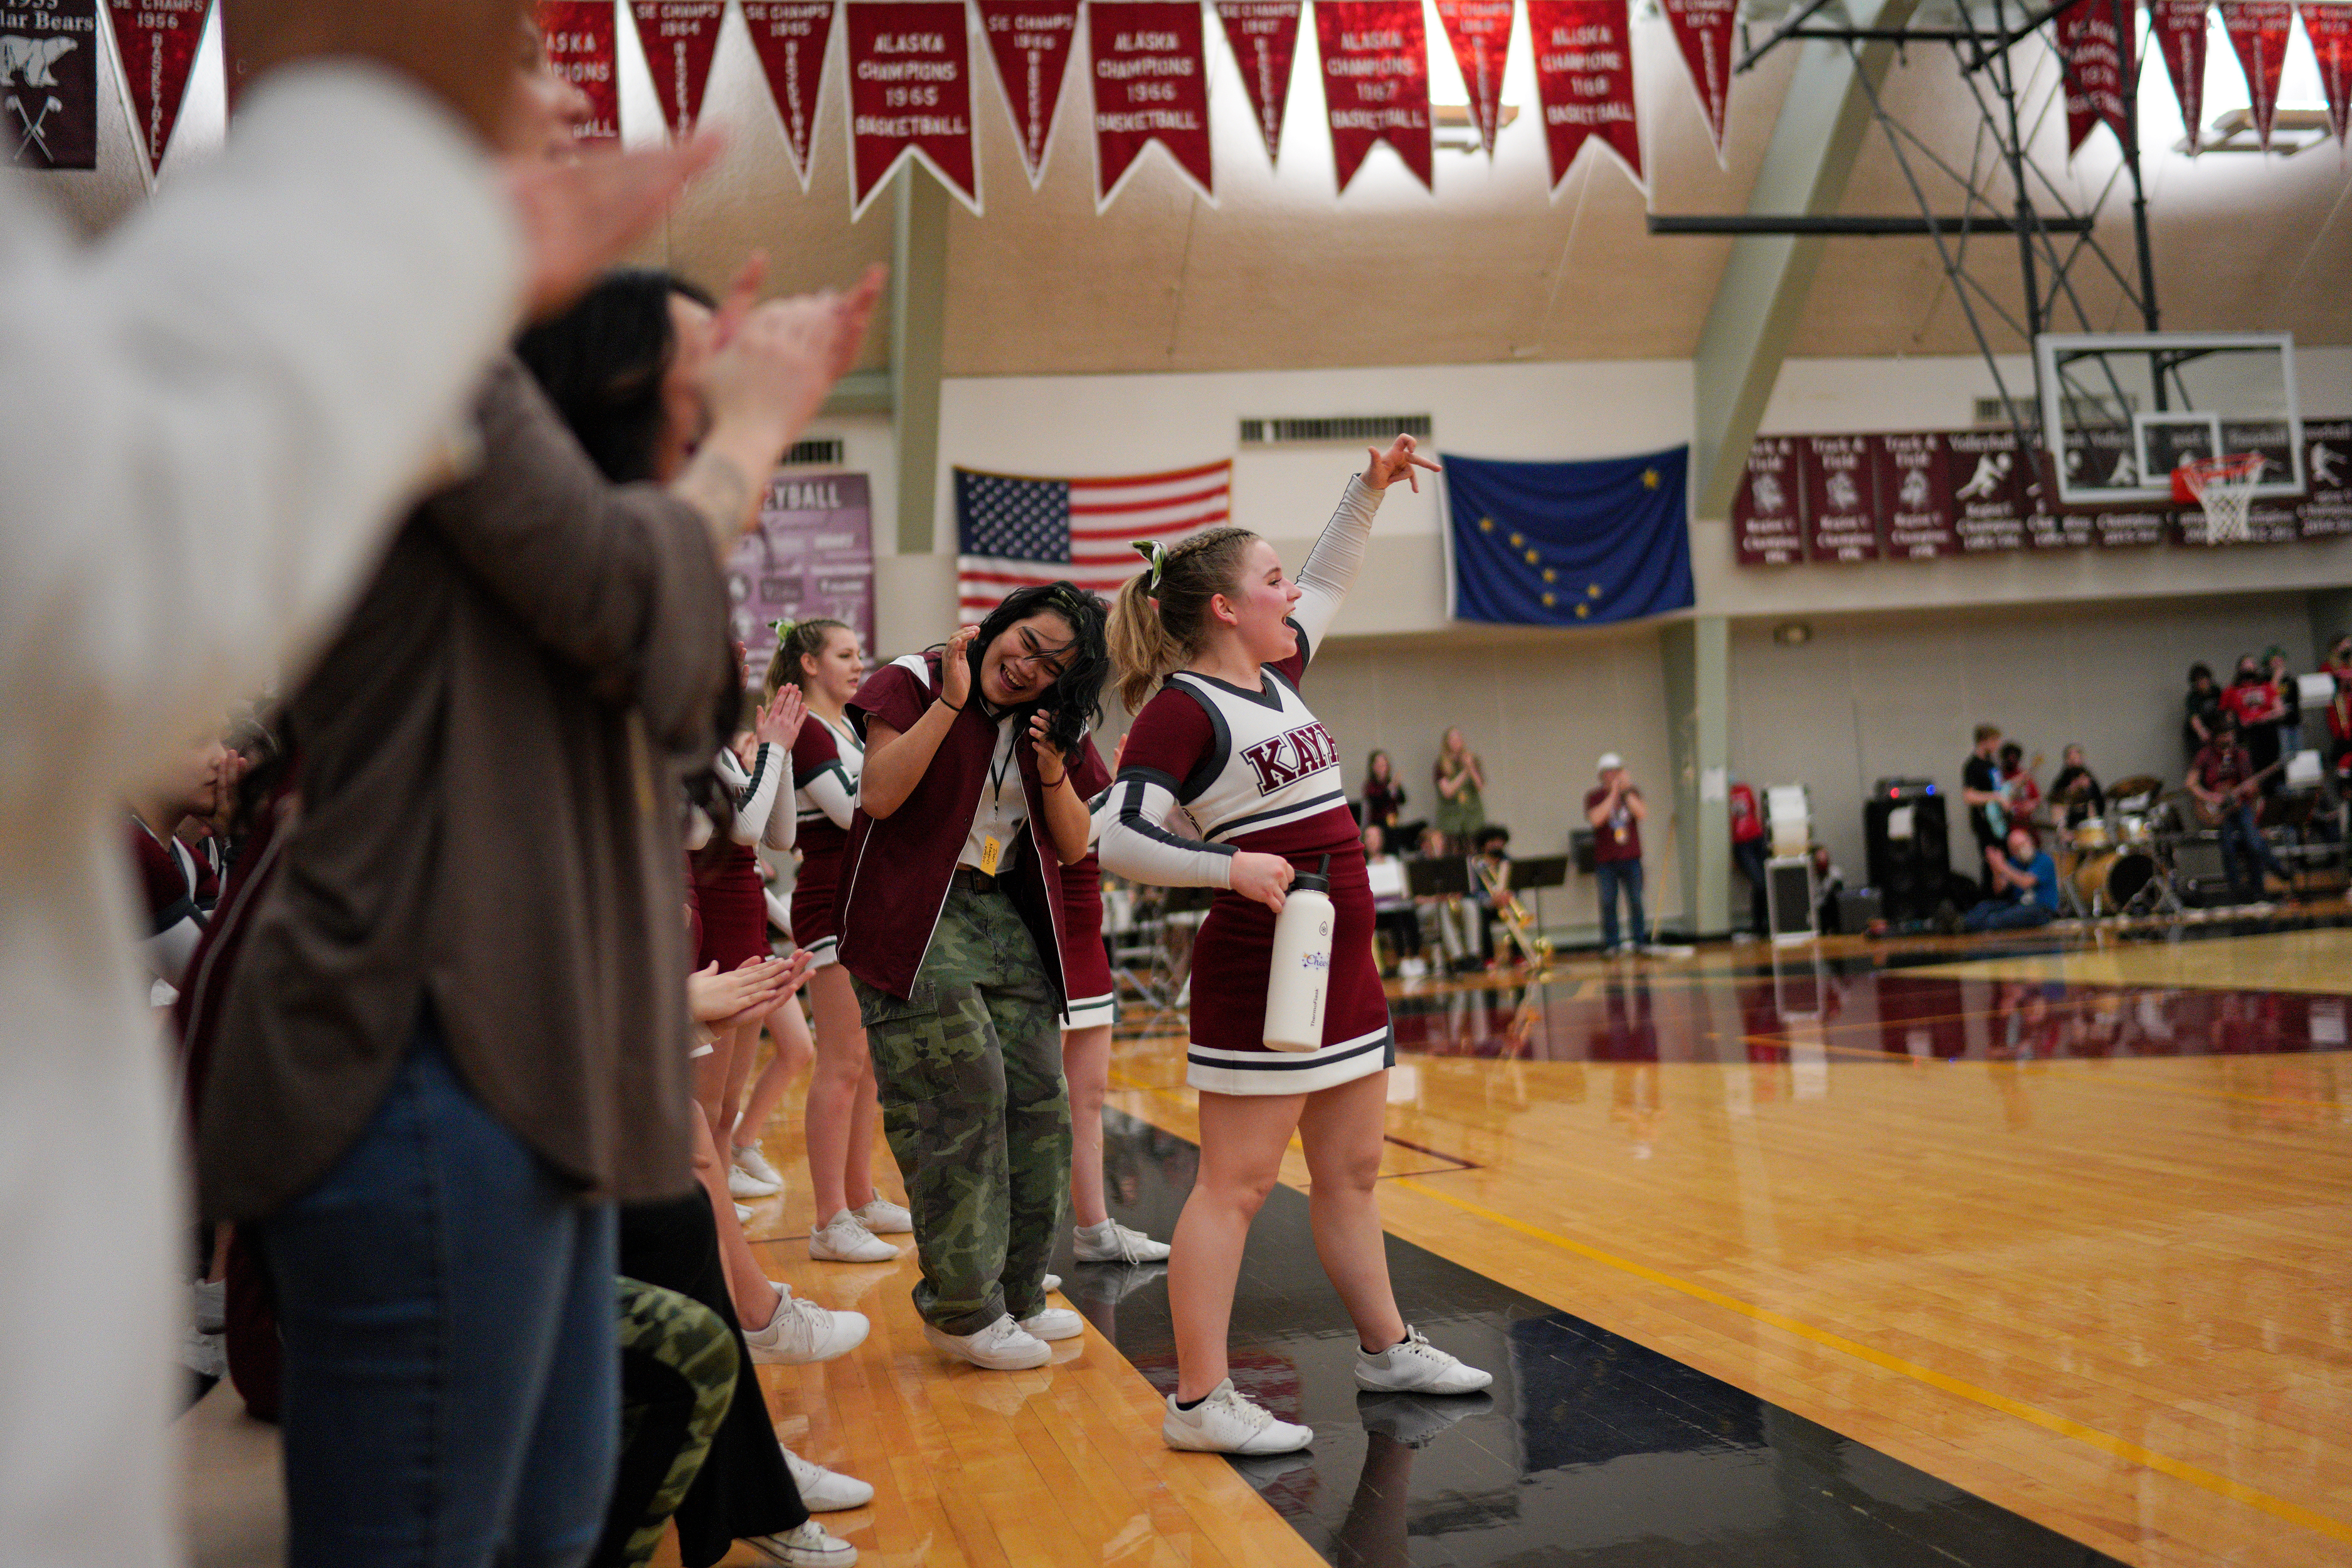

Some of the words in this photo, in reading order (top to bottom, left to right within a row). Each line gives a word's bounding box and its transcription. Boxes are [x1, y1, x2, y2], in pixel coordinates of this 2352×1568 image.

[0, 11, 28, 28] lar
[34, 11, 93, 30] Bears
[546, 32, 596, 53] ASKA
[873, 32, 946, 54] ALASKA
[1113, 31, 1182, 51] ALASKA
[554, 61, 610, 82] PIONS
[857, 60, 956, 82] CHAMPIONS
[1097, 56, 1194, 79] CHAMPIONS
[1327, 56, 1416, 77] CHAMPIONS
[886, 86, 940, 107] 1965
[1127, 82, 1177, 103] 1966
[856, 114, 968, 137] BASKETBALL
[1095, 109, 1200, 133] BASKETBALL
[1310, 988, 1319, 1027] ThermoFlask
